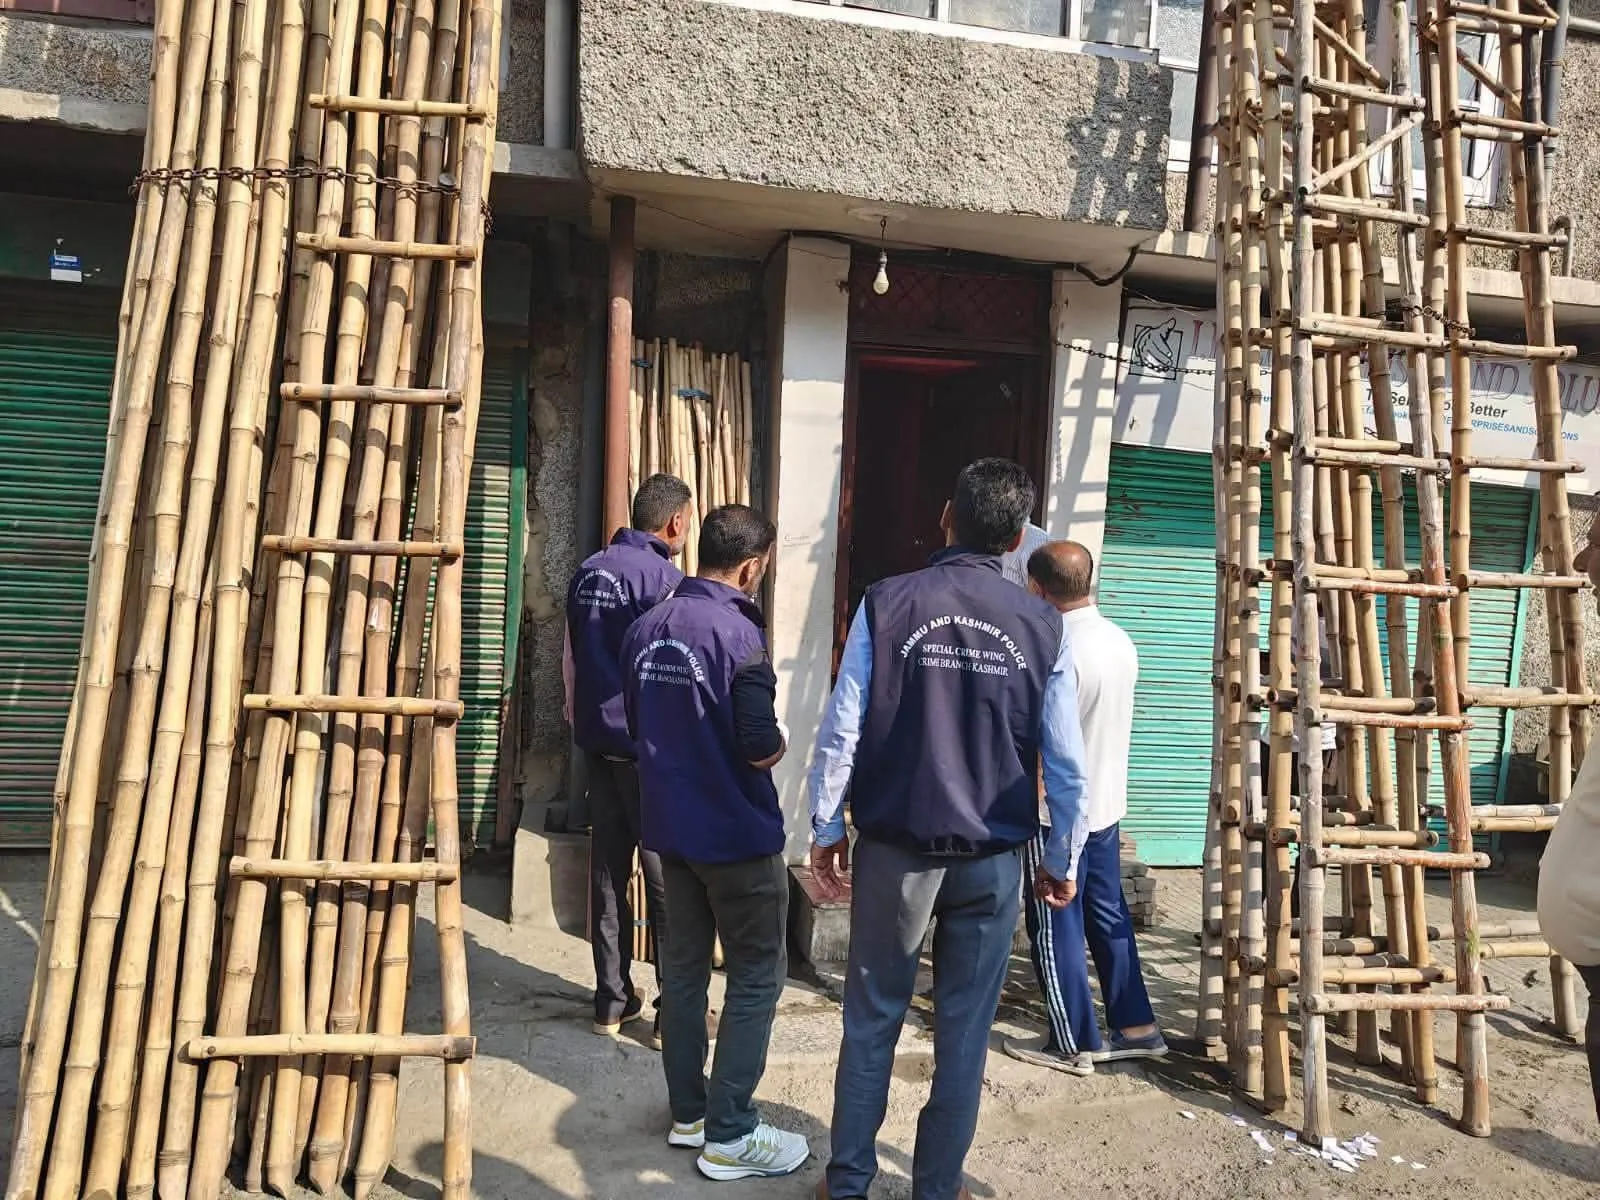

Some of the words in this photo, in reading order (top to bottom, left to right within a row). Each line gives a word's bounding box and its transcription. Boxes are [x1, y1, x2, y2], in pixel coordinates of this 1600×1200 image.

[901, 625, 928, 658] JAMMU
[930, 615, 951, 630] AND
[953, 615, 1001, 638] KASHMIR
[1000, 634, 1027, 670] POLICE
[922, 643, 954, 656] SPECIAL
[955, 647, 981, 659] CRIME
[982, 650, 1005, 663] WING
[972, 662, 1009, 676] KASHMIR
